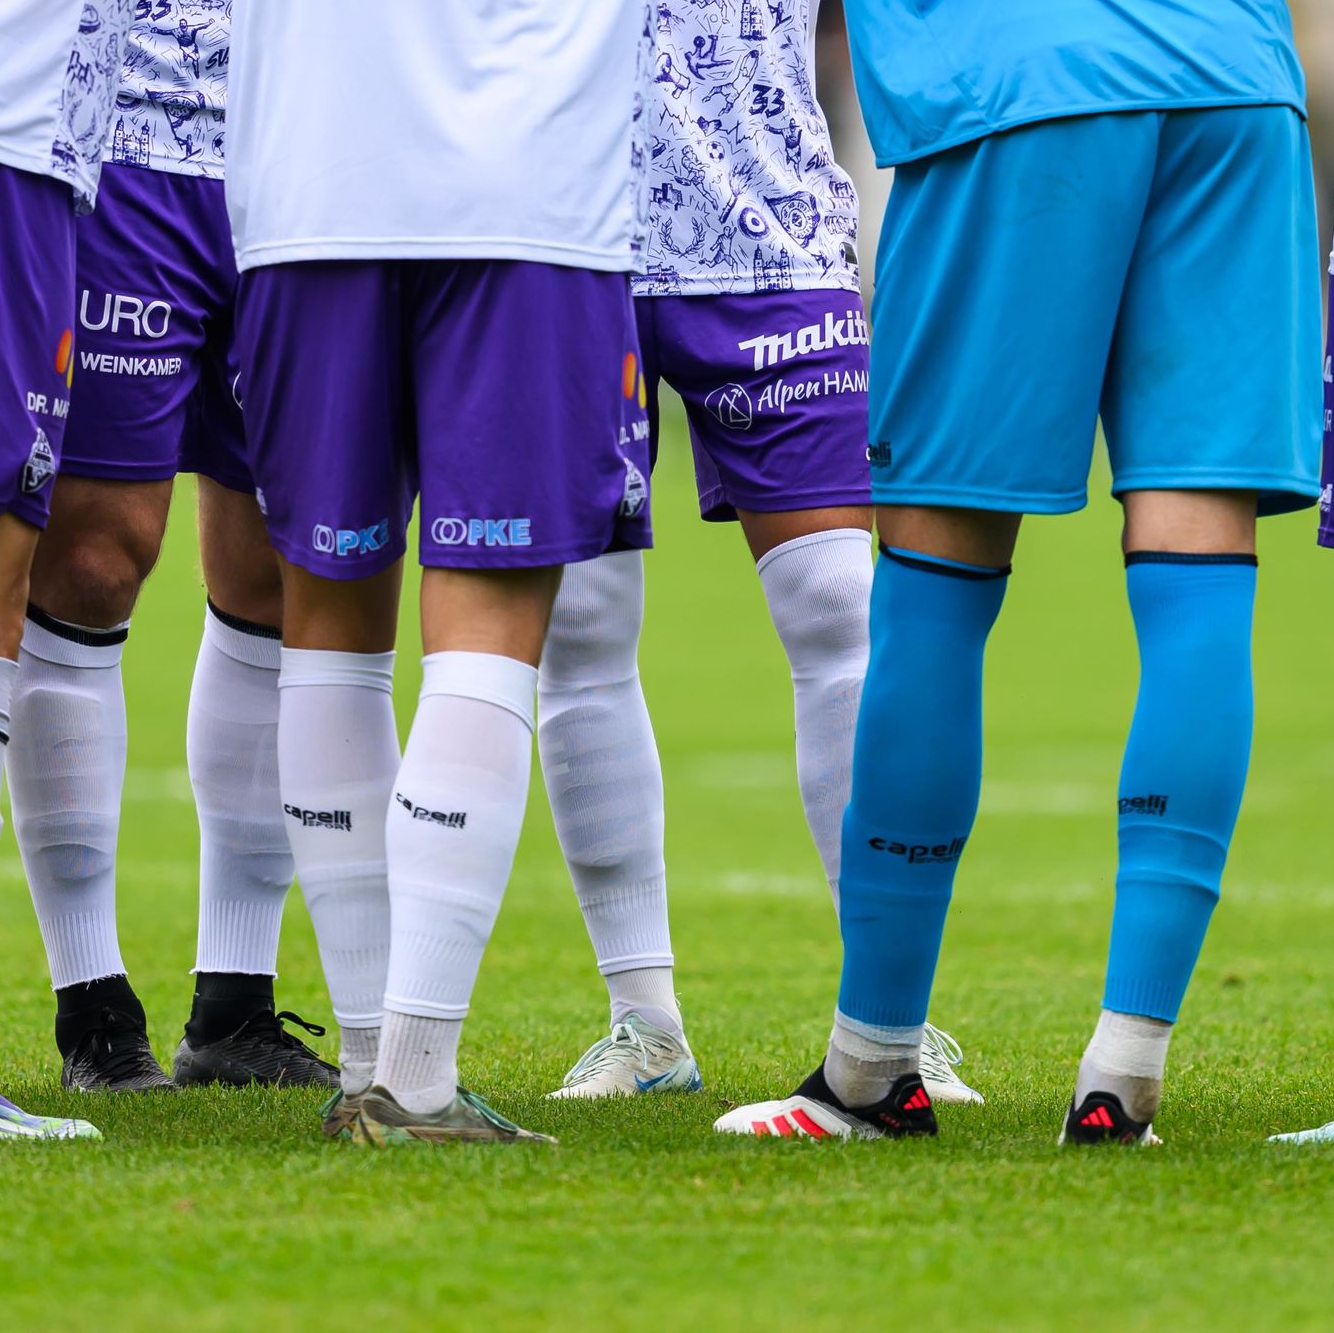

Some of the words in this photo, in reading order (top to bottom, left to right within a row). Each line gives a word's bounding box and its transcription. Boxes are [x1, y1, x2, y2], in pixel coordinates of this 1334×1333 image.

[80, 290, 172, 338] URO
[80, 351, 182, 376] WEINKAMER
[757, 379, 820, 413] Alpen
[824, 369, 869, 395] HAM
[467, 519, 531, 546] PKE
[284, 803, 352, 826] capelli
[396, 792, 467, 826] capelli
[1117, 795, 1168, 814] pelli
[869, 836, 966, 863] capelli
